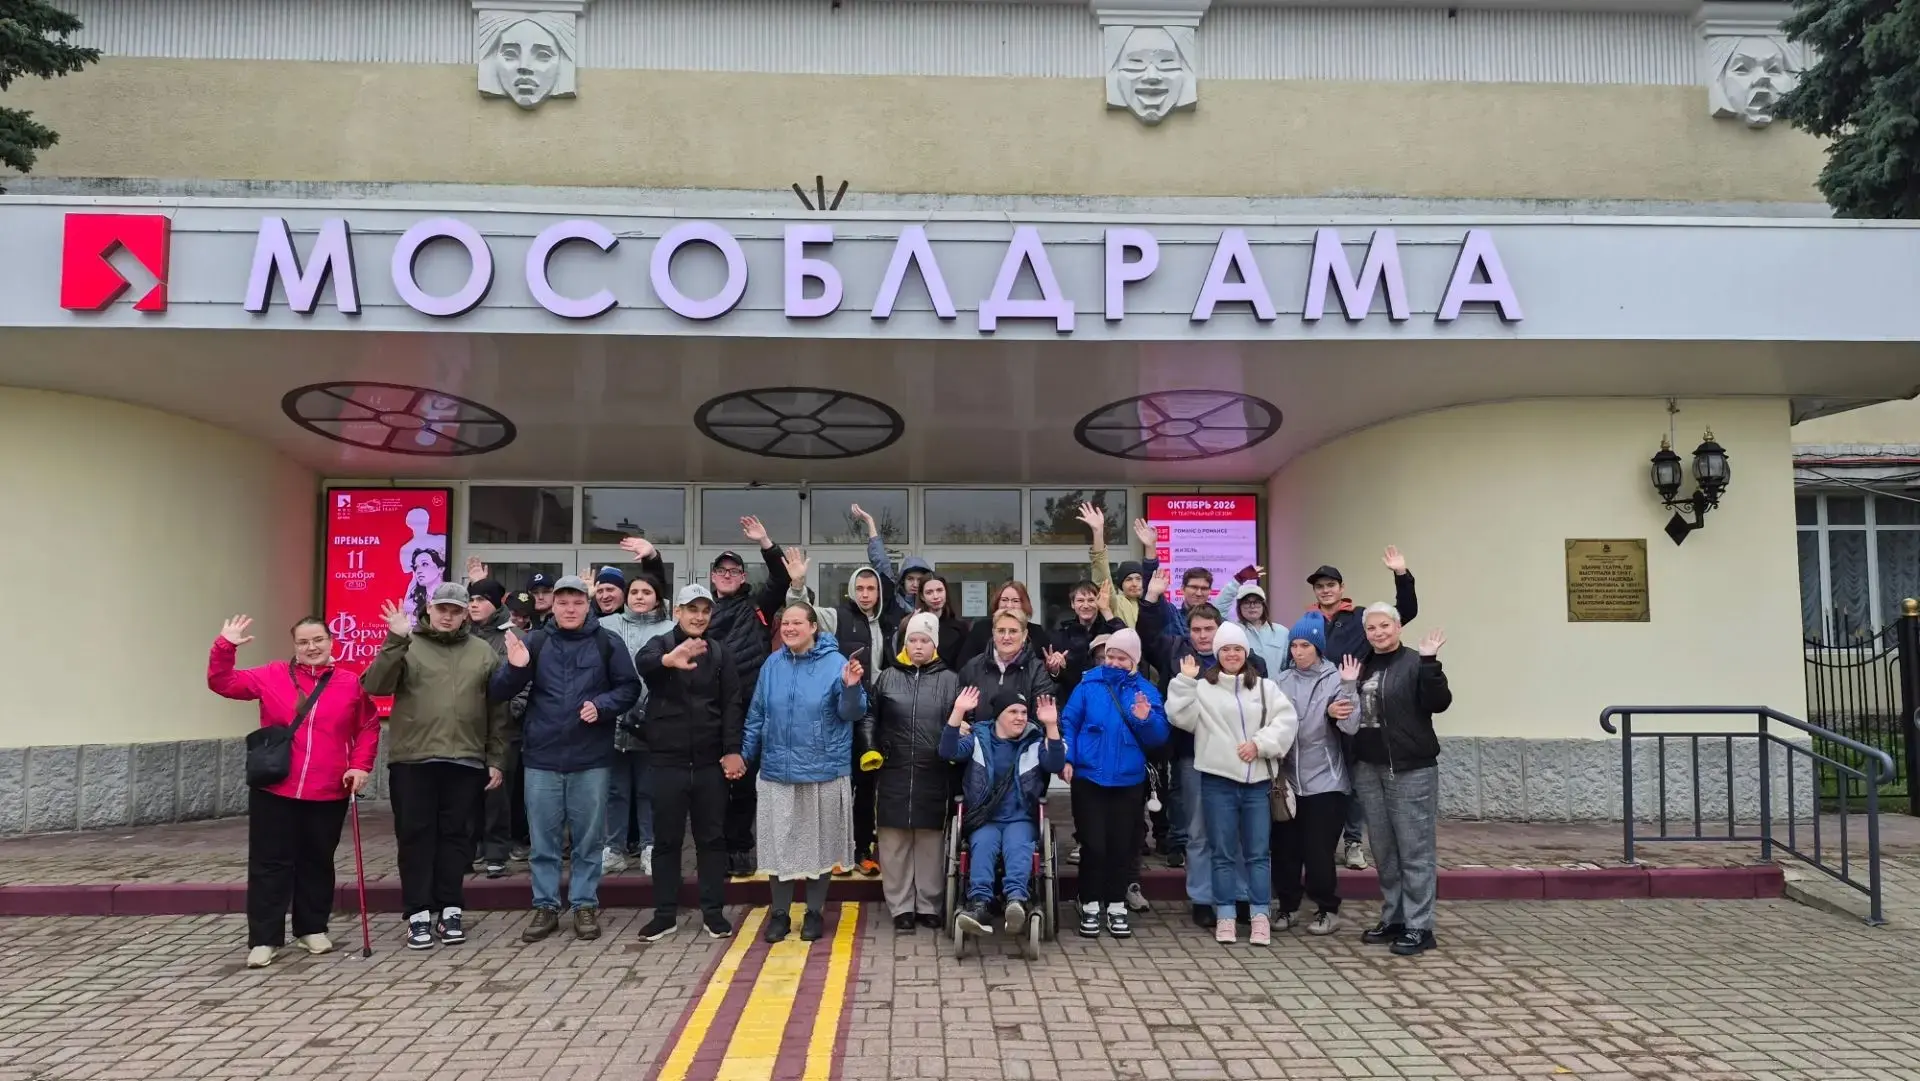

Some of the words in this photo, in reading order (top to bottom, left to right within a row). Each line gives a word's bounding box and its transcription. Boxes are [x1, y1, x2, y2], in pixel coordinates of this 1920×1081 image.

[243, 215, 1524, 334] МОСОБЛДРАМА
[1167, 500, 1212, 509] ОКТЯБРЬ
[1213, 500, 1236, 509] 2026
[334, 536, 380, 545] ПРЕМЬЕРА
[347, 550, 365, 569] 11
[335, 570, 375, 581] октября
